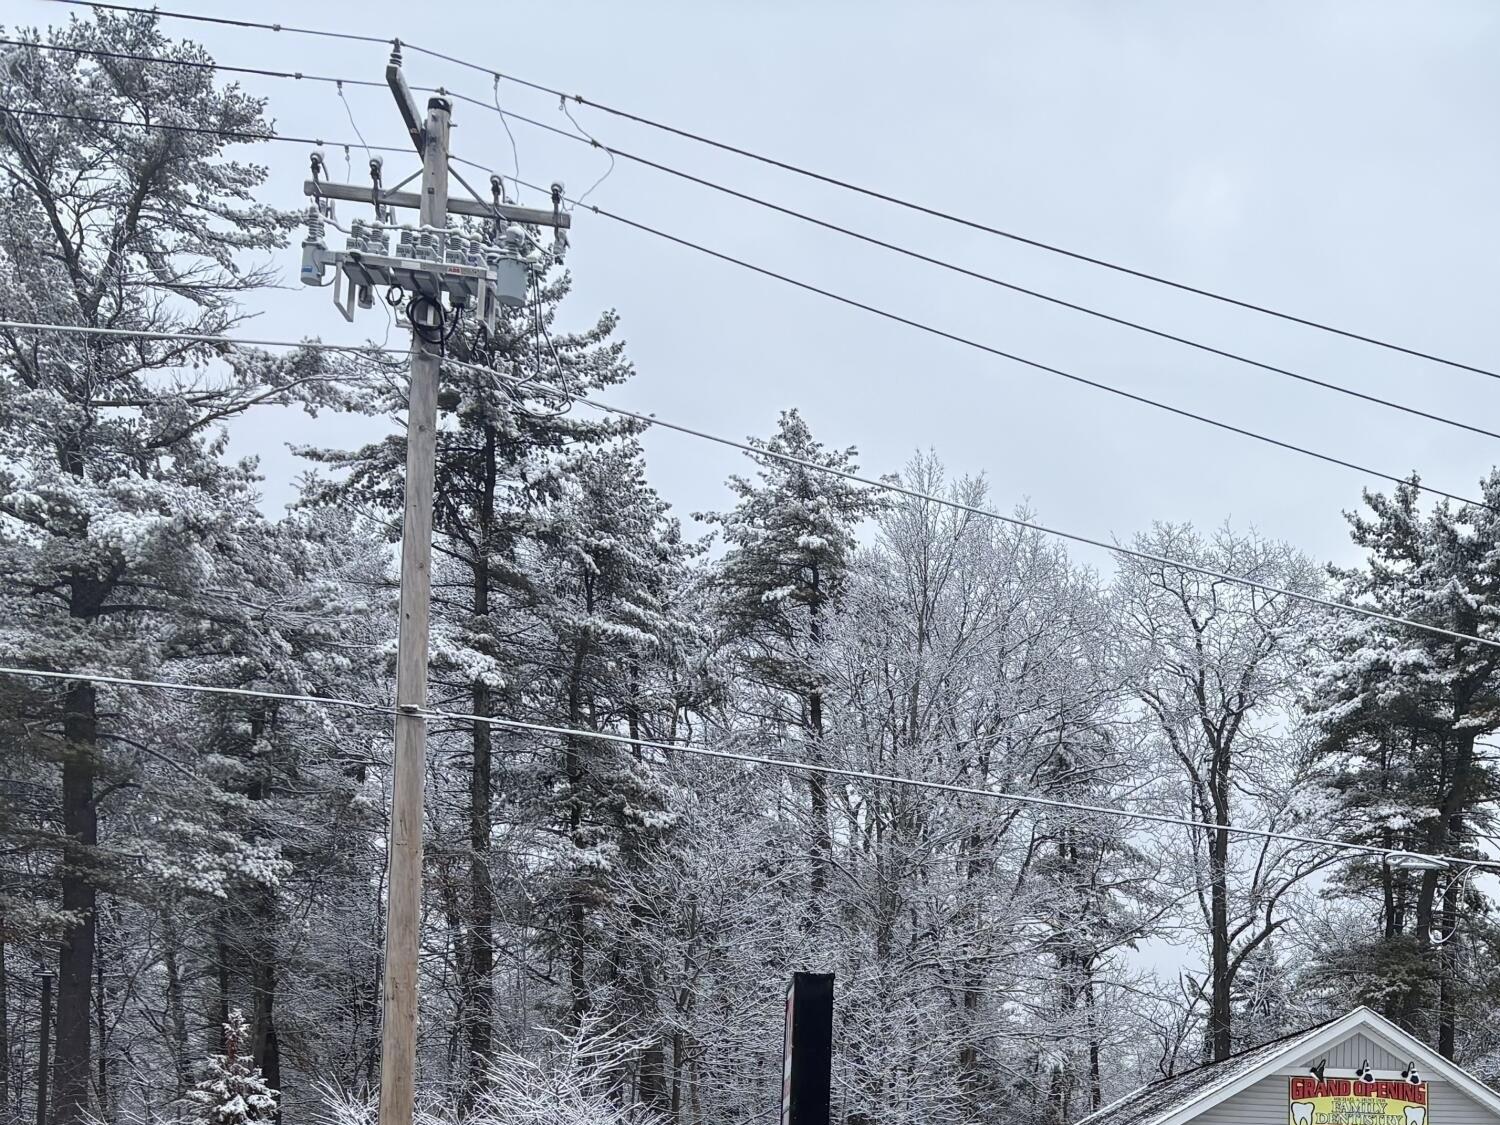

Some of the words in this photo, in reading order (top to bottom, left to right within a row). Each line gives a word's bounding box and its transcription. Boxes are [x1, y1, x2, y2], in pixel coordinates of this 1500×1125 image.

[1291, 1077, 1351, 1100] GRAND
[1354, 1080, 1426, 1105] OPENING
[1331, 1101, 1388, 1114] FAMILY
[1315, 1113, 1404, 1125] DENTISTRY
